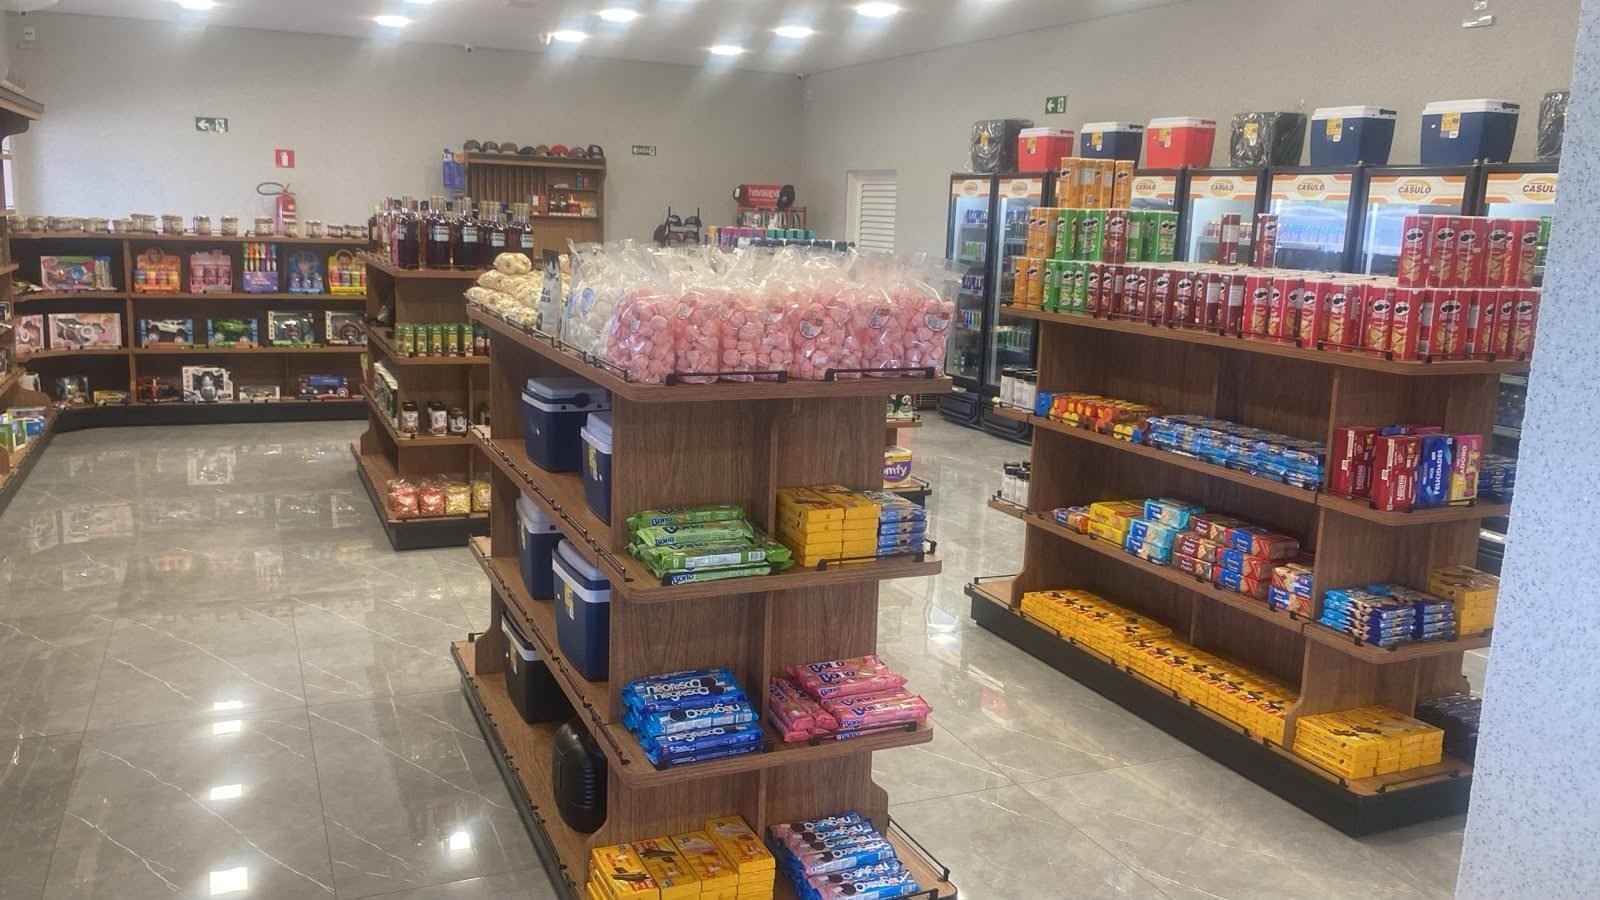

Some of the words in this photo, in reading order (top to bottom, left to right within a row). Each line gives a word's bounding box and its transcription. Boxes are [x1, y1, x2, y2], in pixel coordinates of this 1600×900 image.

[1398, 186, 1431, 194] CASULO
[1523, 185, 1556, 193] CASUL
[1459, 445, 1468, 474] ADORO
[1434, 449, 1443, 495] FELICIDADES
